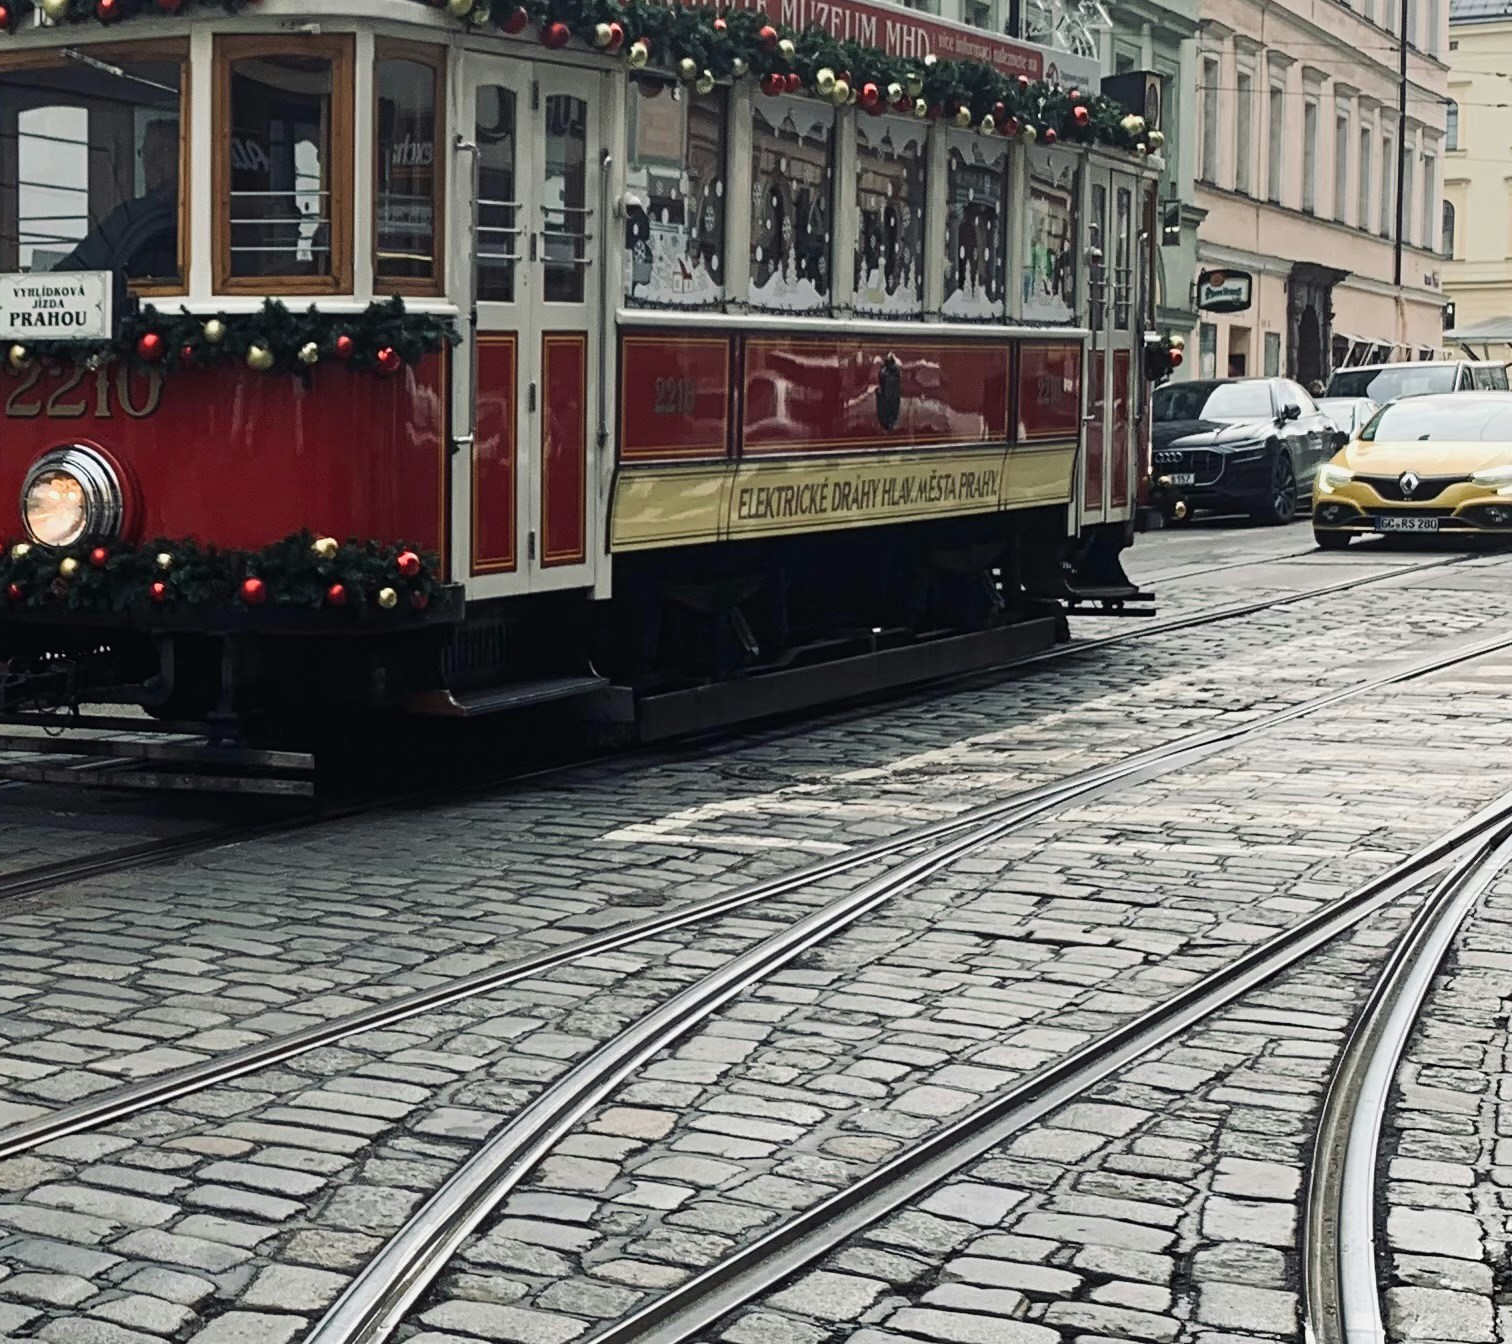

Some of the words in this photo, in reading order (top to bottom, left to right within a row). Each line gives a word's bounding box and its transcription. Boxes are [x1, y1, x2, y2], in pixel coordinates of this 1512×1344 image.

[885, 19, 931, 59] MHD
[13, 284, 85, 297] VYHLÍDKOVÁ
[32, 297, 65, 309] JÍZDA
[9, 311, 87, 327] PRAHOU
[5, 358, 164, 419] 2210
[738, 476, 829, 520] ELEKTRICKÉ
[830, 474, 881, 512] DRÁHY
